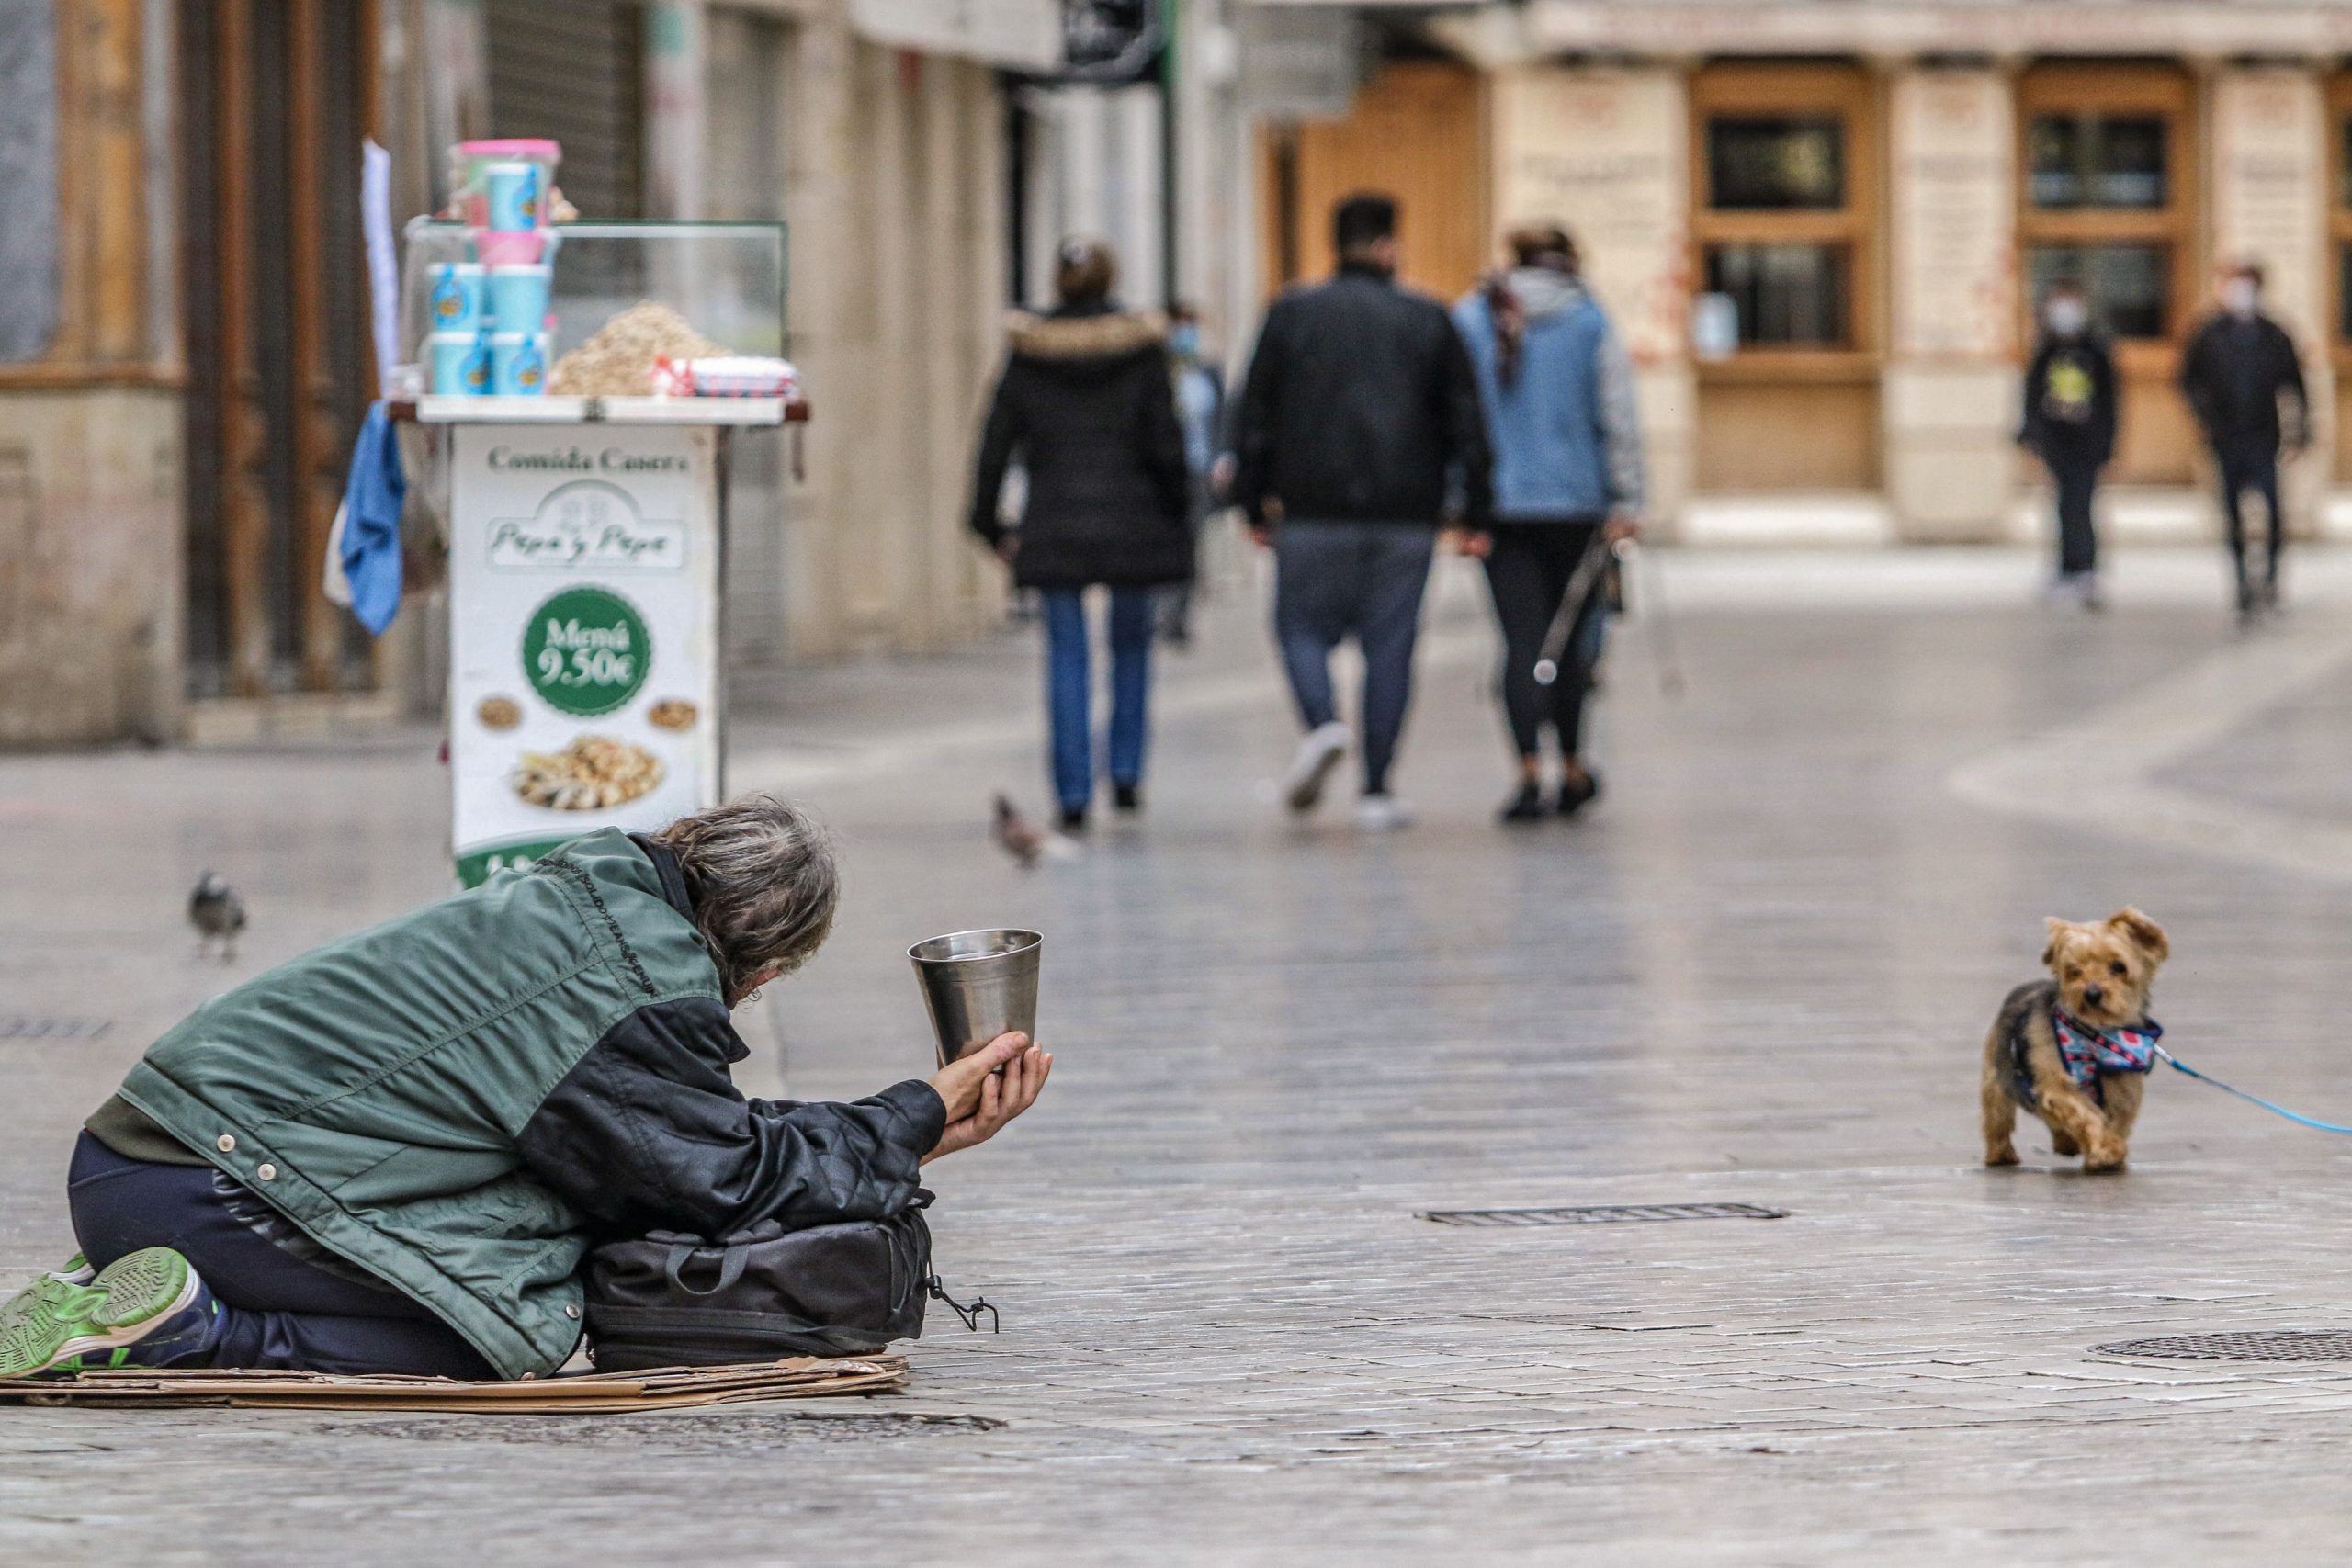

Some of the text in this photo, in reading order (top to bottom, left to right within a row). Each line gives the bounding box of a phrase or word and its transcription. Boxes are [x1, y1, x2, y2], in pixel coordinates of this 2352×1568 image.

[488, 446, 687, 472] Comida Casera
[546, 618, 630, 650] Menú
[537, 648, 636, 687] 9.50€
